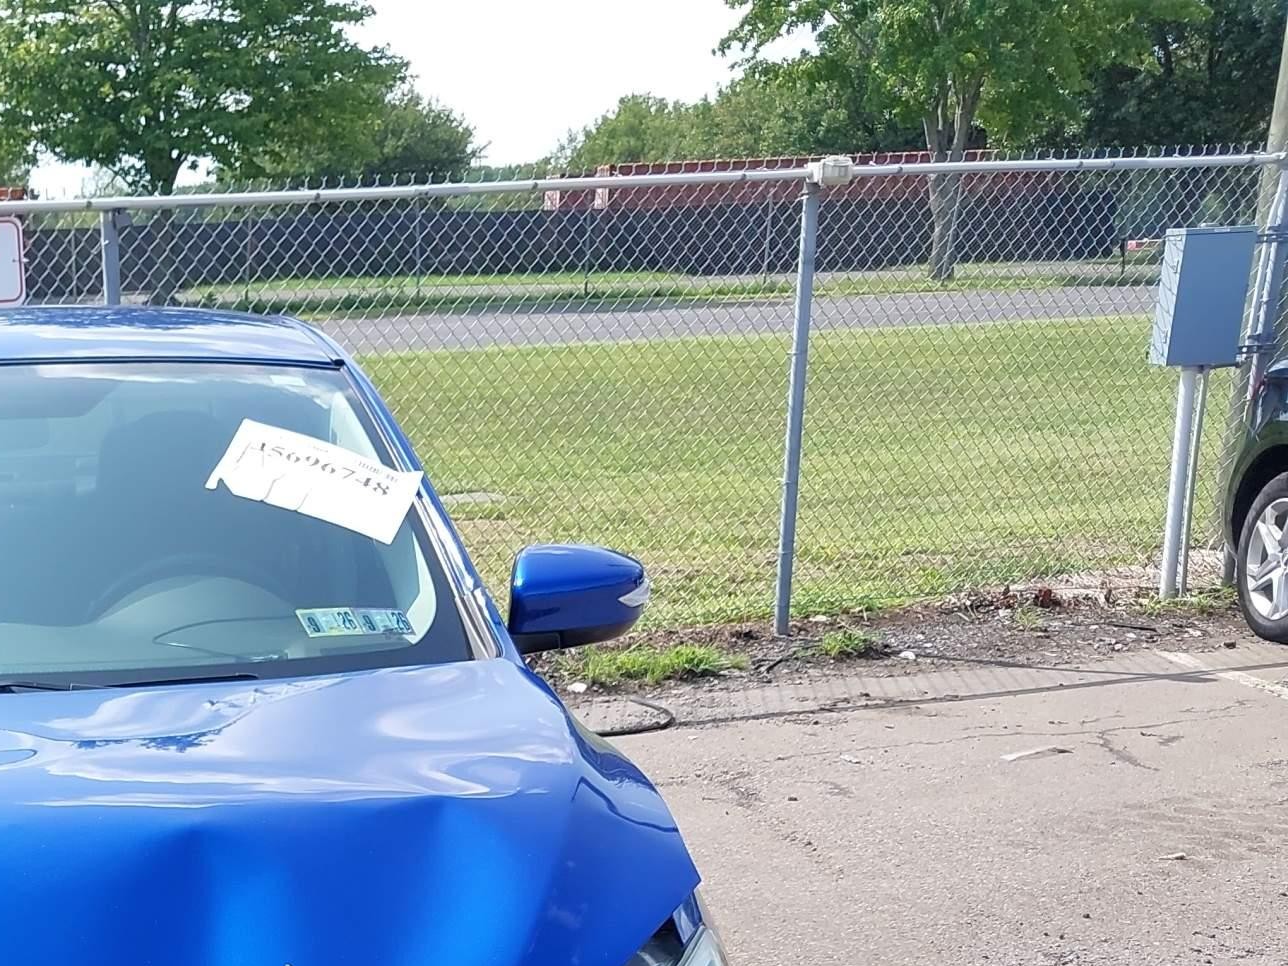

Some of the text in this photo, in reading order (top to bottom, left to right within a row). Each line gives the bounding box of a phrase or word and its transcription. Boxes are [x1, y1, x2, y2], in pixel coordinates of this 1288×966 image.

[306, 611, 358, 633] 9 26
[362, 611, 412, 632] 9 26
